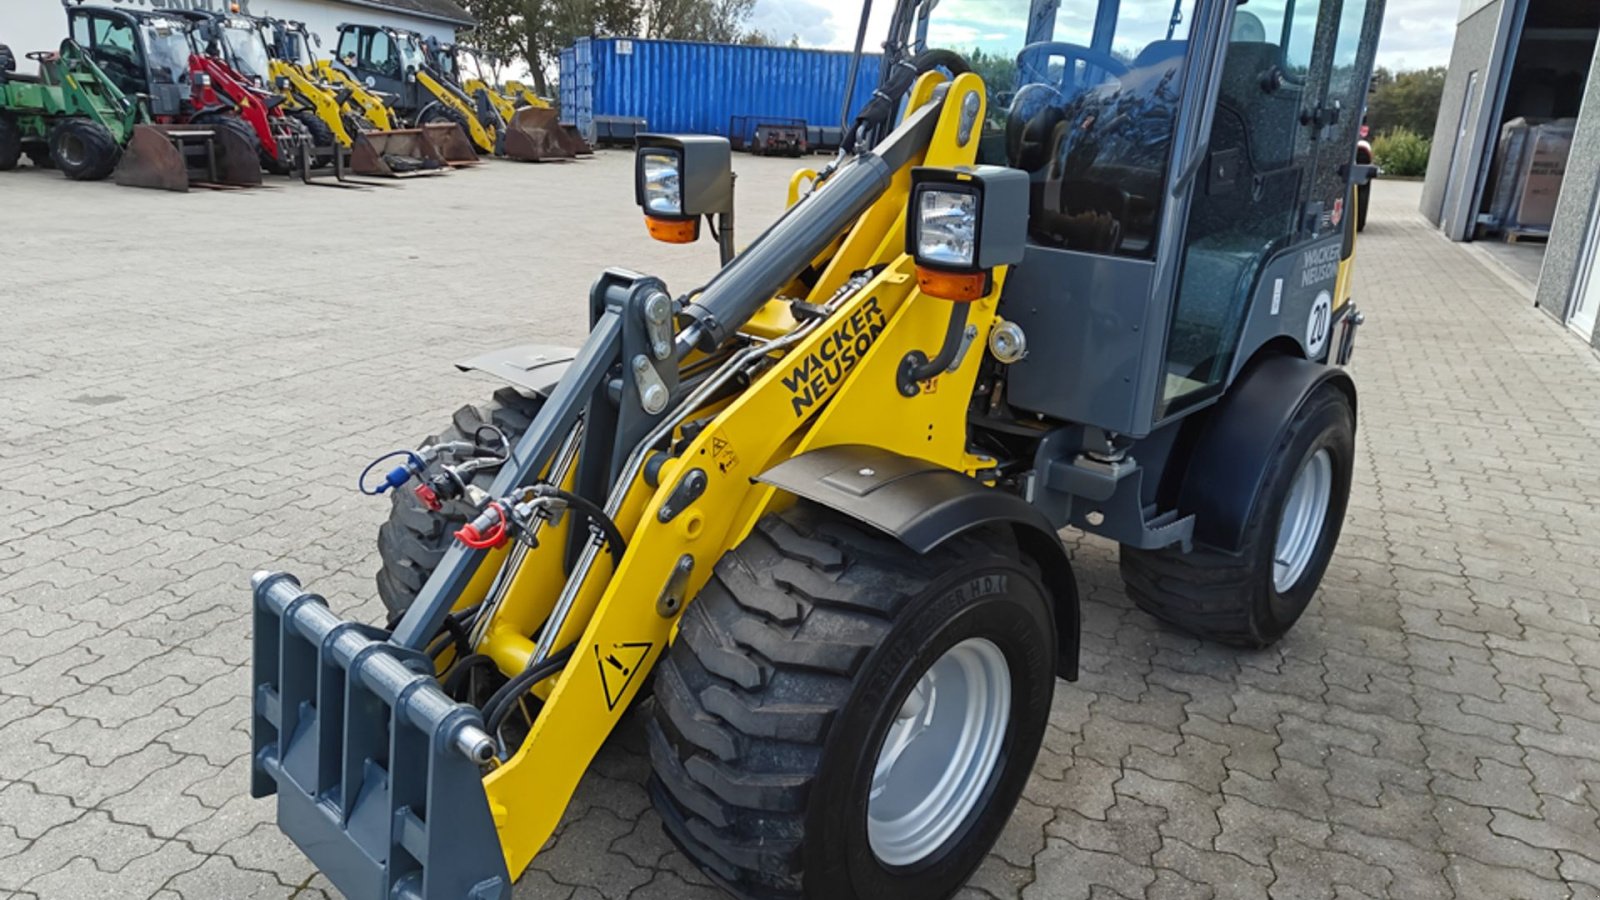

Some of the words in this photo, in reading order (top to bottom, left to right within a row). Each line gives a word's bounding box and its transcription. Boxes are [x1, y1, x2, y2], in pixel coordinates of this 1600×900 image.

[1303, 243, 1341, 268] WACKER
[781, 296, 882, 393] WACKER
[1310, 302, 1327, 346] 20
[791, 313, 887, 418] NEUSON
